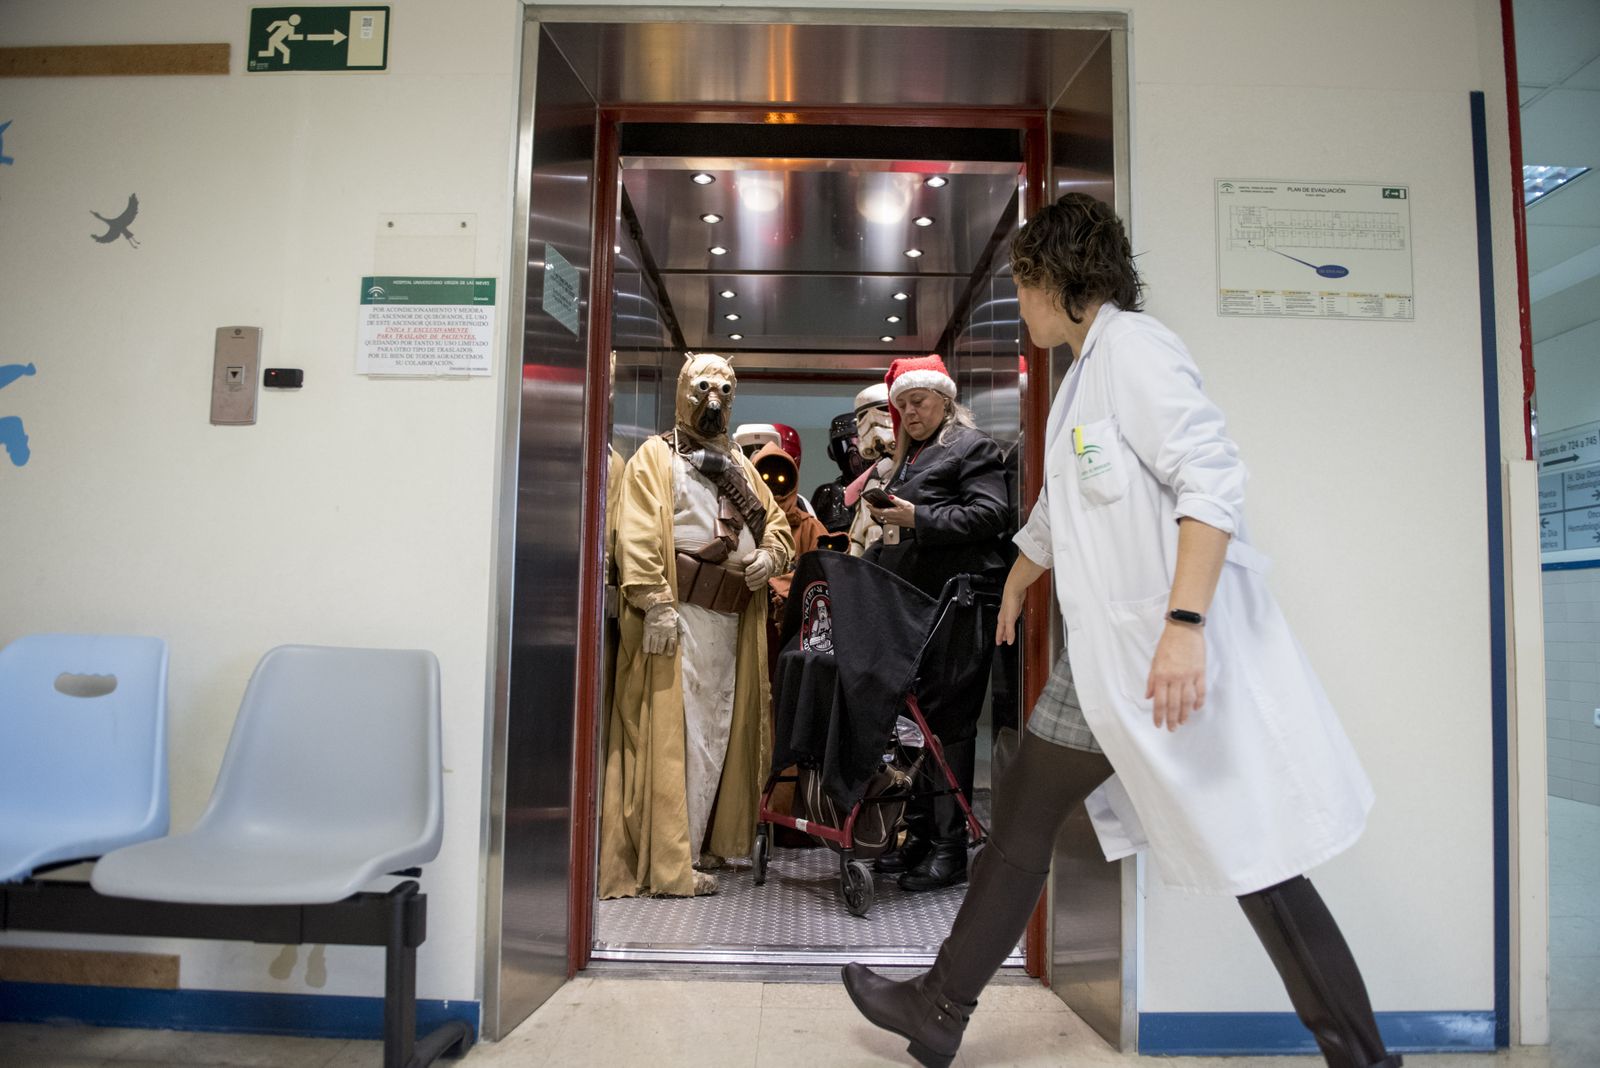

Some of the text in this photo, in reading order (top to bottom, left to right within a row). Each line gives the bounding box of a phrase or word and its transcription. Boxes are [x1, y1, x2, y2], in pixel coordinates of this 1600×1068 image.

[1560, 443, 1566, 452] de
[1568, 440, 1579, 450] 724
[1585, 436, 1597, 446] 745
